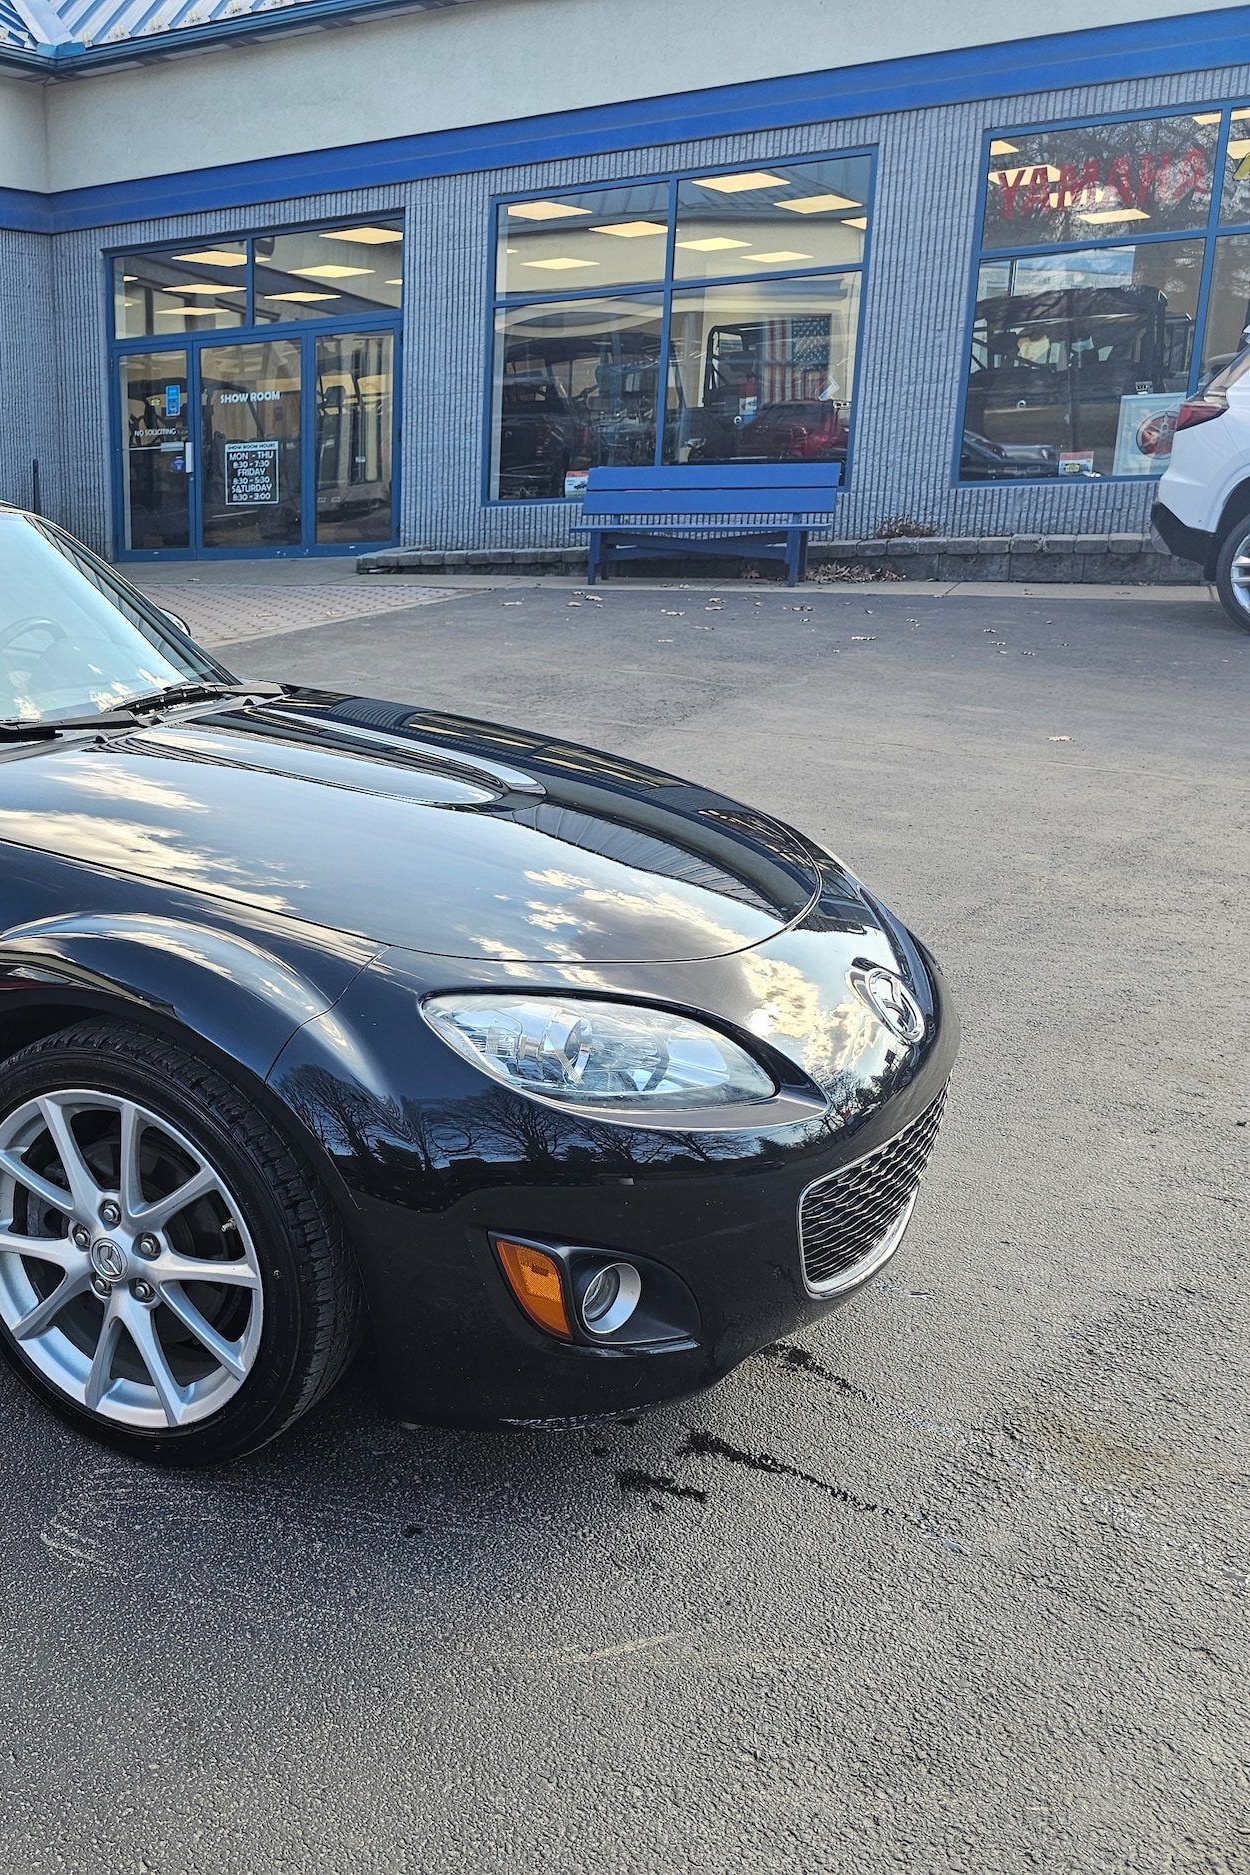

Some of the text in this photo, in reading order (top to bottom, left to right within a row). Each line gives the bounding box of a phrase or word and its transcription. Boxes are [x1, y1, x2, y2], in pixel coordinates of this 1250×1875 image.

[998, 146, 1208, 219] YAMAHA
[220, 391, 280, 404] SHOW ROOM
[145, 428, 176, 436] SOLICITING
[230, 452, 249, 460] MON
[257, 451, 274, 459] THU
[232, 461, 248, 469] 8:30
[237, 467, 266, 476] FRIDAY
[233, 477, 248, 485] 8:30
[231, 483, 272, 493] SATURDAY
[253, 492, 271, 500] 3:00
